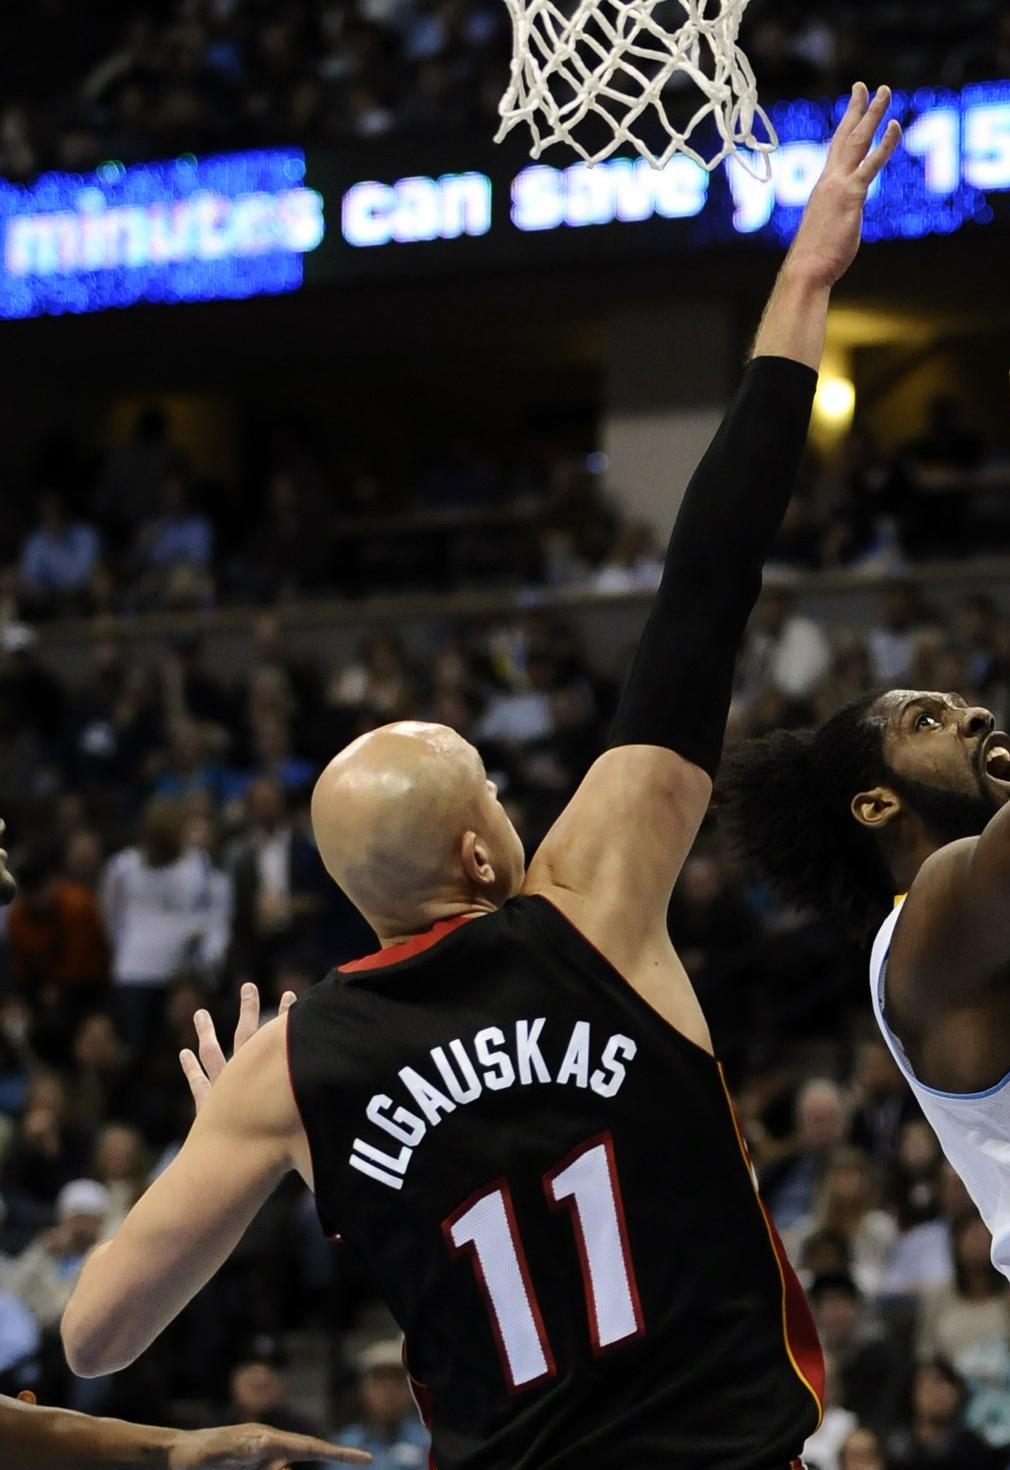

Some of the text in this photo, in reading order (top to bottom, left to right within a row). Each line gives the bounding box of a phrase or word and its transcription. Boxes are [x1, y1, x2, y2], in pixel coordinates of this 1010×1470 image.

[8, 186, 323, 275] minutes
[342, 181, 491, 247] can
[511, 150, 706, 230] save
[727, 140, 880, 232] yo
[348, 1017, 637, 1190] ILGAUSKAS
[441, 1129, 646, 1396] 11
